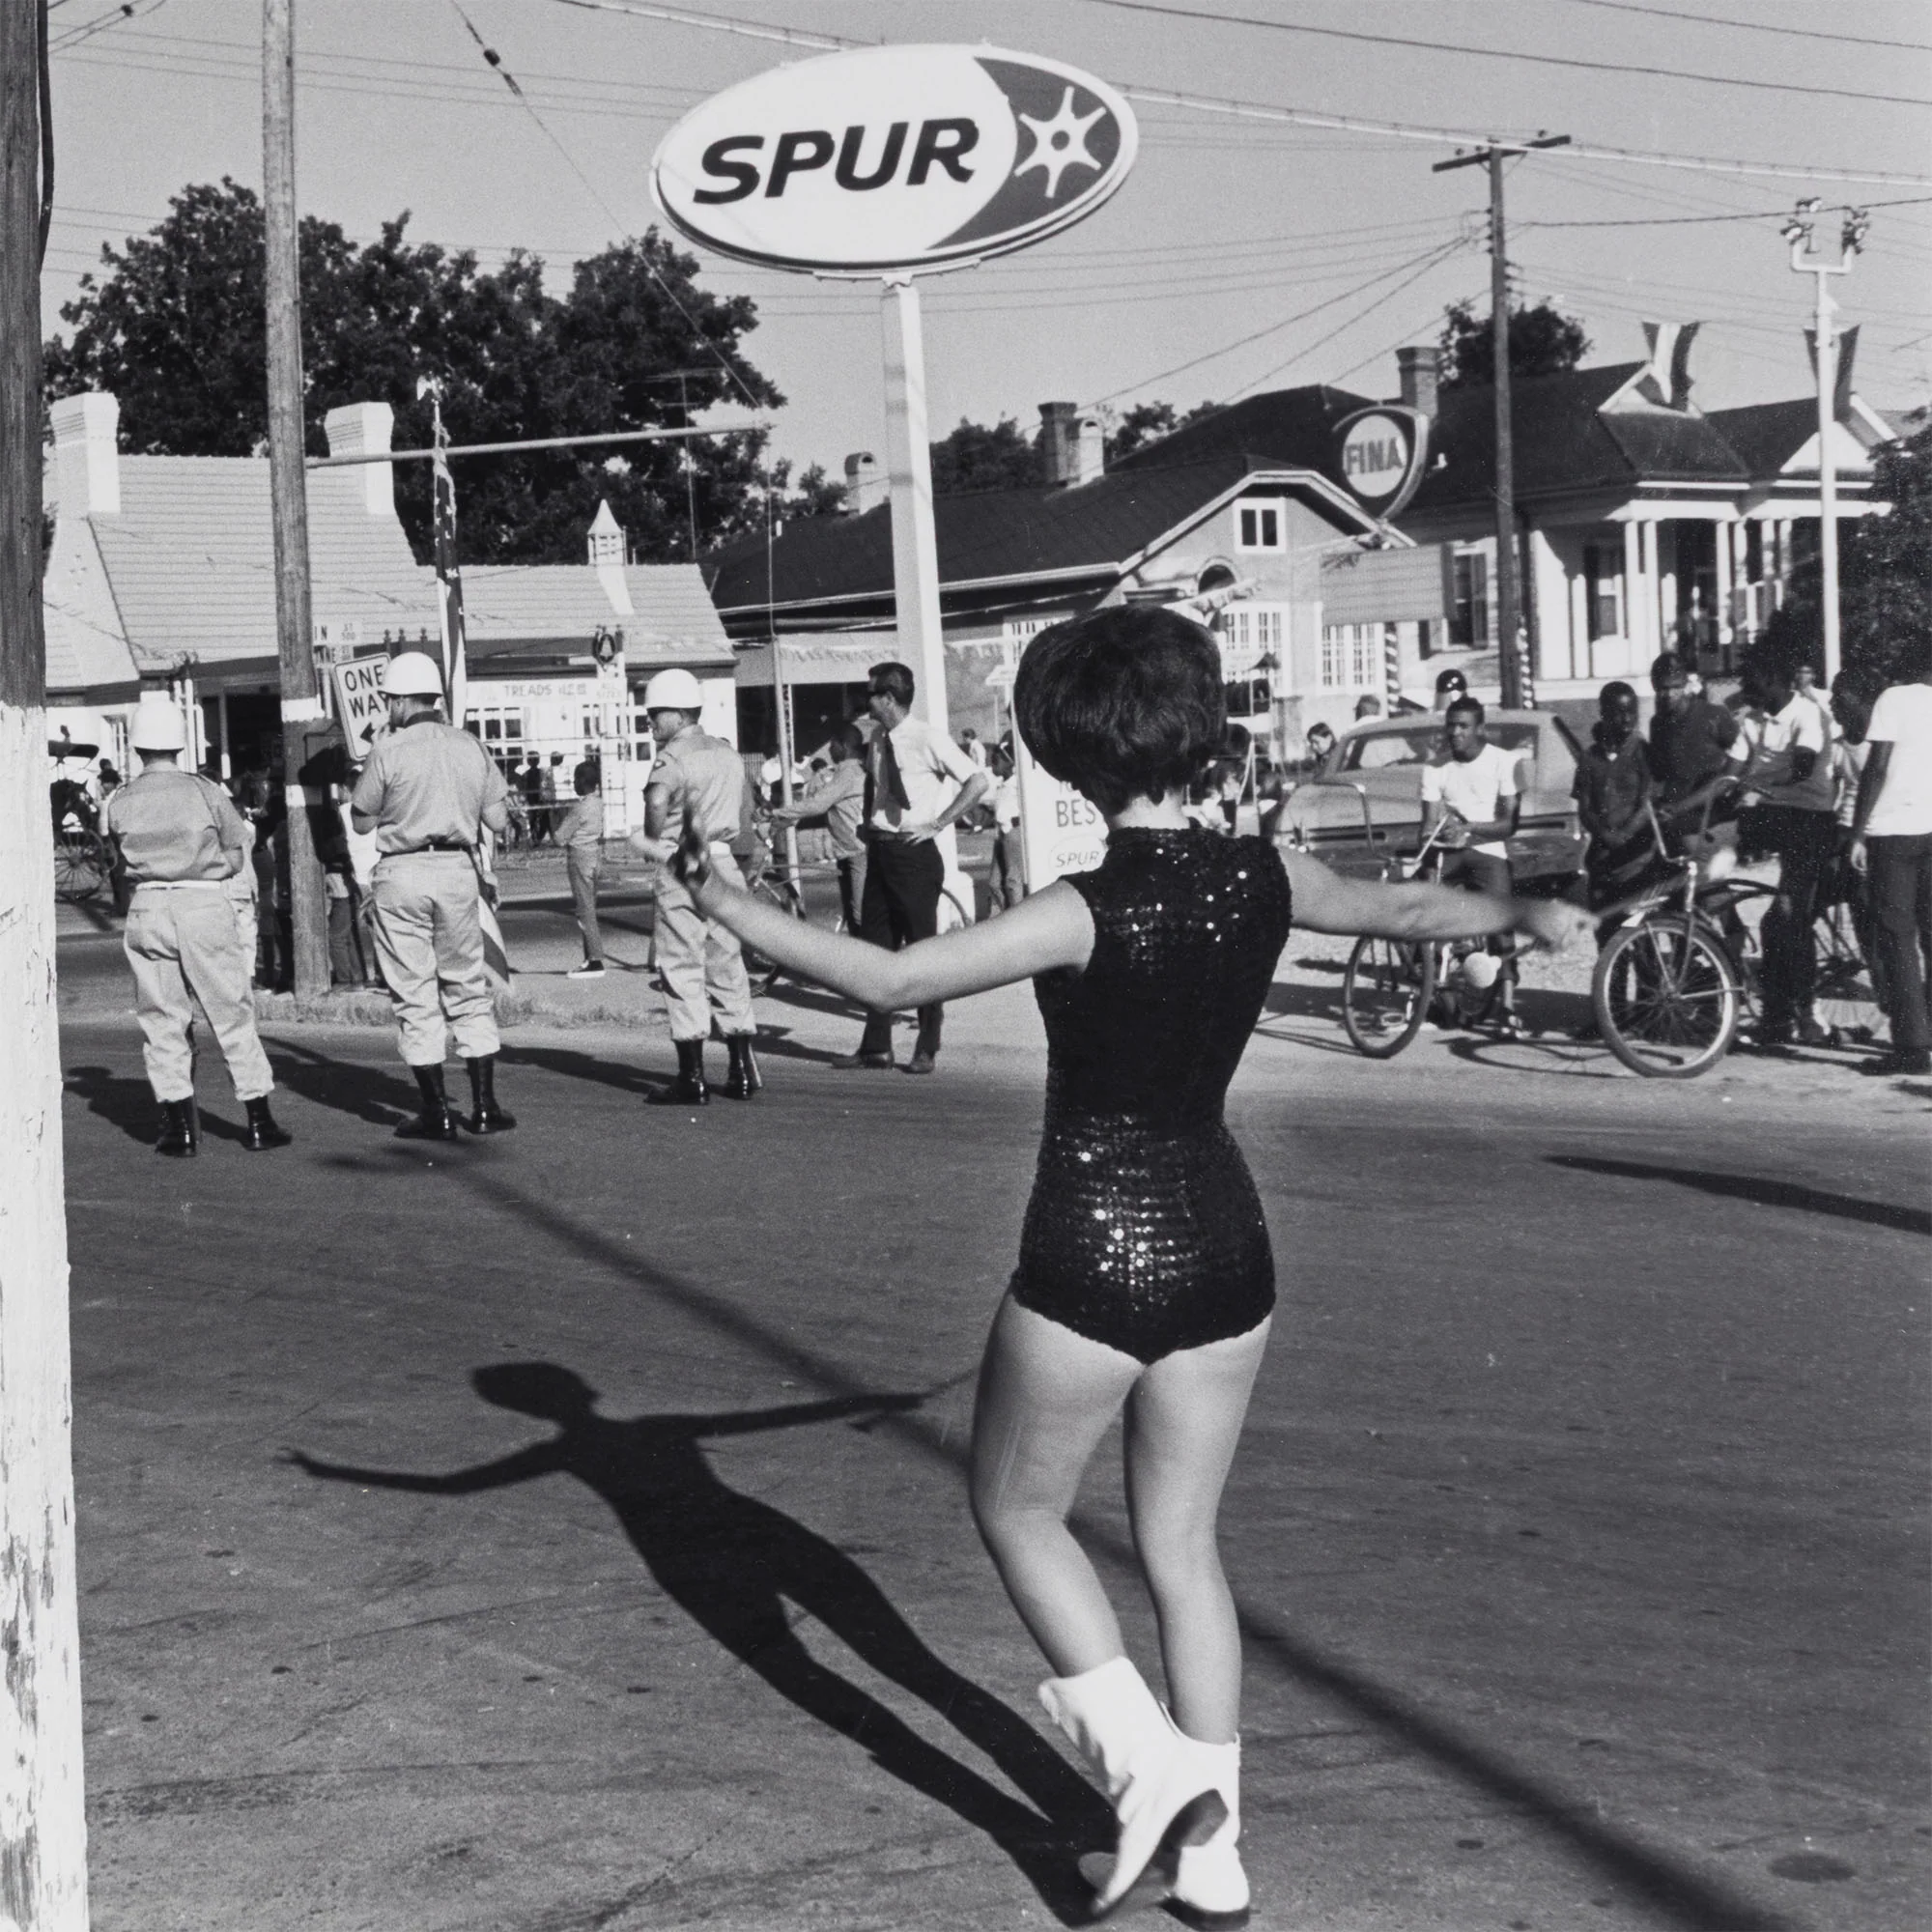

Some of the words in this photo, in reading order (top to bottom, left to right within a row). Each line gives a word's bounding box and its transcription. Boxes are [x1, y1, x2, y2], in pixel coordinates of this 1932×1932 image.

[693, 117, 980, 205] SPUR
[1347, 437, 1405, 475] FINA
[345, 665, 383, 692] ONE
[504, 684, 553, 696] TREADS
[1056, 799, 1096, 828] BES
[1055, 851, 1099, 868] SPUR
